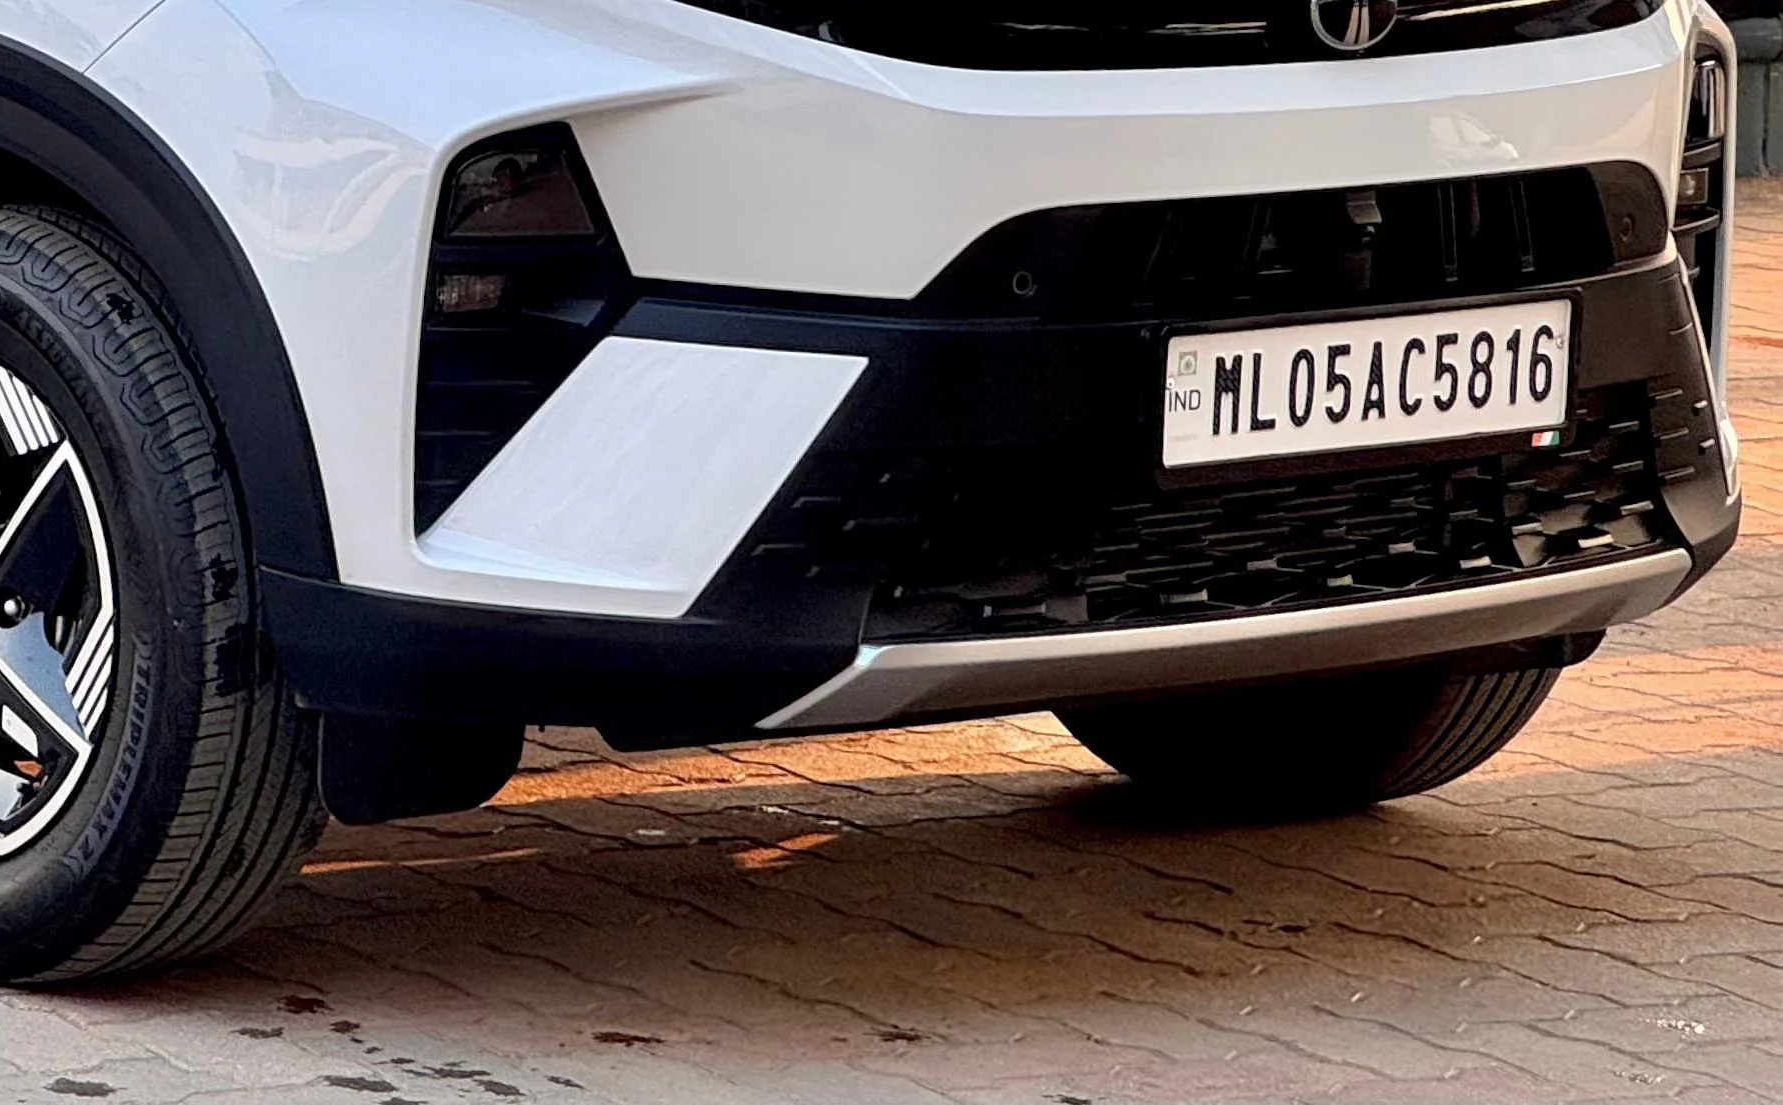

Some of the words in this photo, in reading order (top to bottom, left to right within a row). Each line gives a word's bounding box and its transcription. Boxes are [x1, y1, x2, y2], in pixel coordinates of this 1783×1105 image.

[1169, 389, 1201, 412] IND
[1212, 325, 1554, 436] ML05AC5816
[92, 663, 151, 839] TRIPLEMAX
